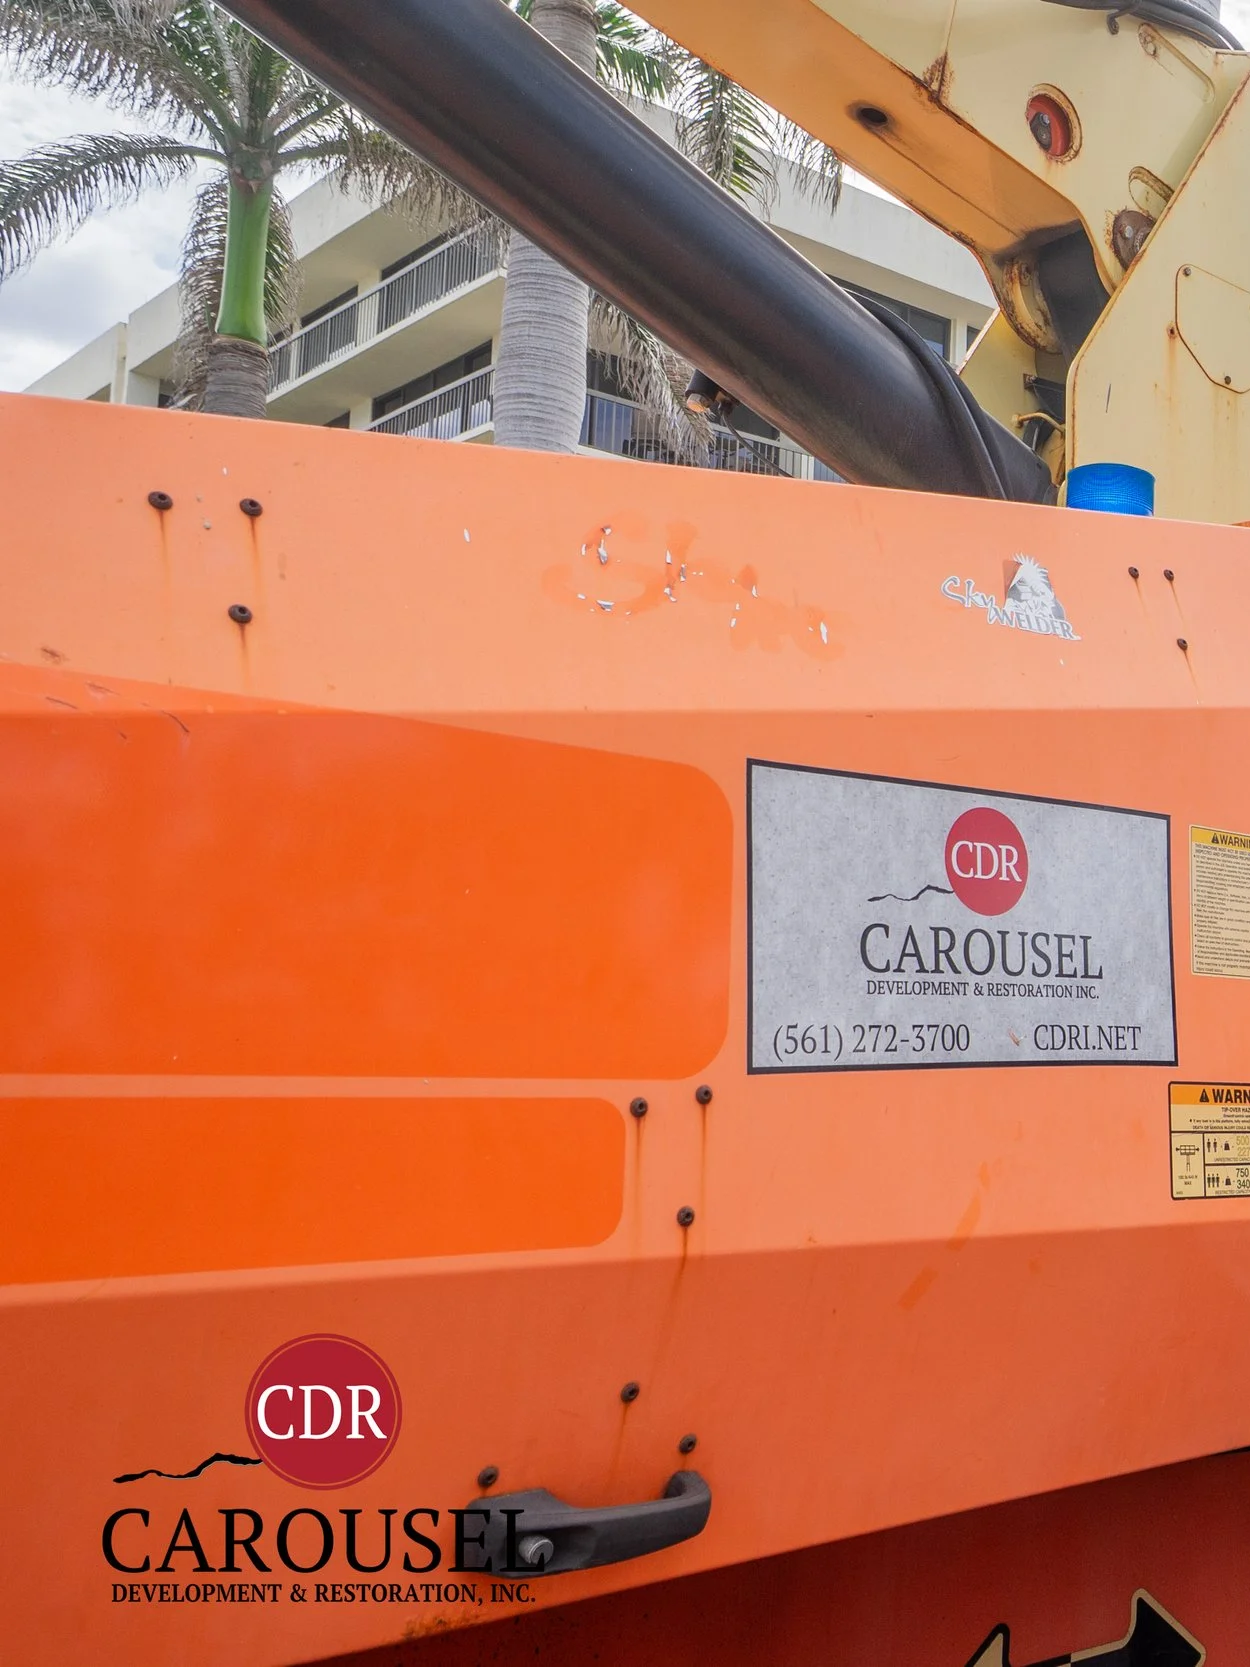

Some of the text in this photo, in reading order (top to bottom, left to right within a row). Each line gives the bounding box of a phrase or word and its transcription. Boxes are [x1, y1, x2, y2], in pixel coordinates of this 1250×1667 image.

[940, 576, 997, 625] Sky
[994, 605, 1076, 640] WELDER
[951, 840, 1022, 882] CDR
[860, 923, 1103, 979] CAROUSEL
[866, 980, 1100, 1000] DEVELOPMENT & RESTORATION INC.
[773, 1023, 1142, 1062] (561) 272-3700 CDRI.NET
[1236, 1135, 1249, 1145] 500
[1236, 1167, 1250, 1178] 750
[1236, 1179, 1250, 1190] 340
